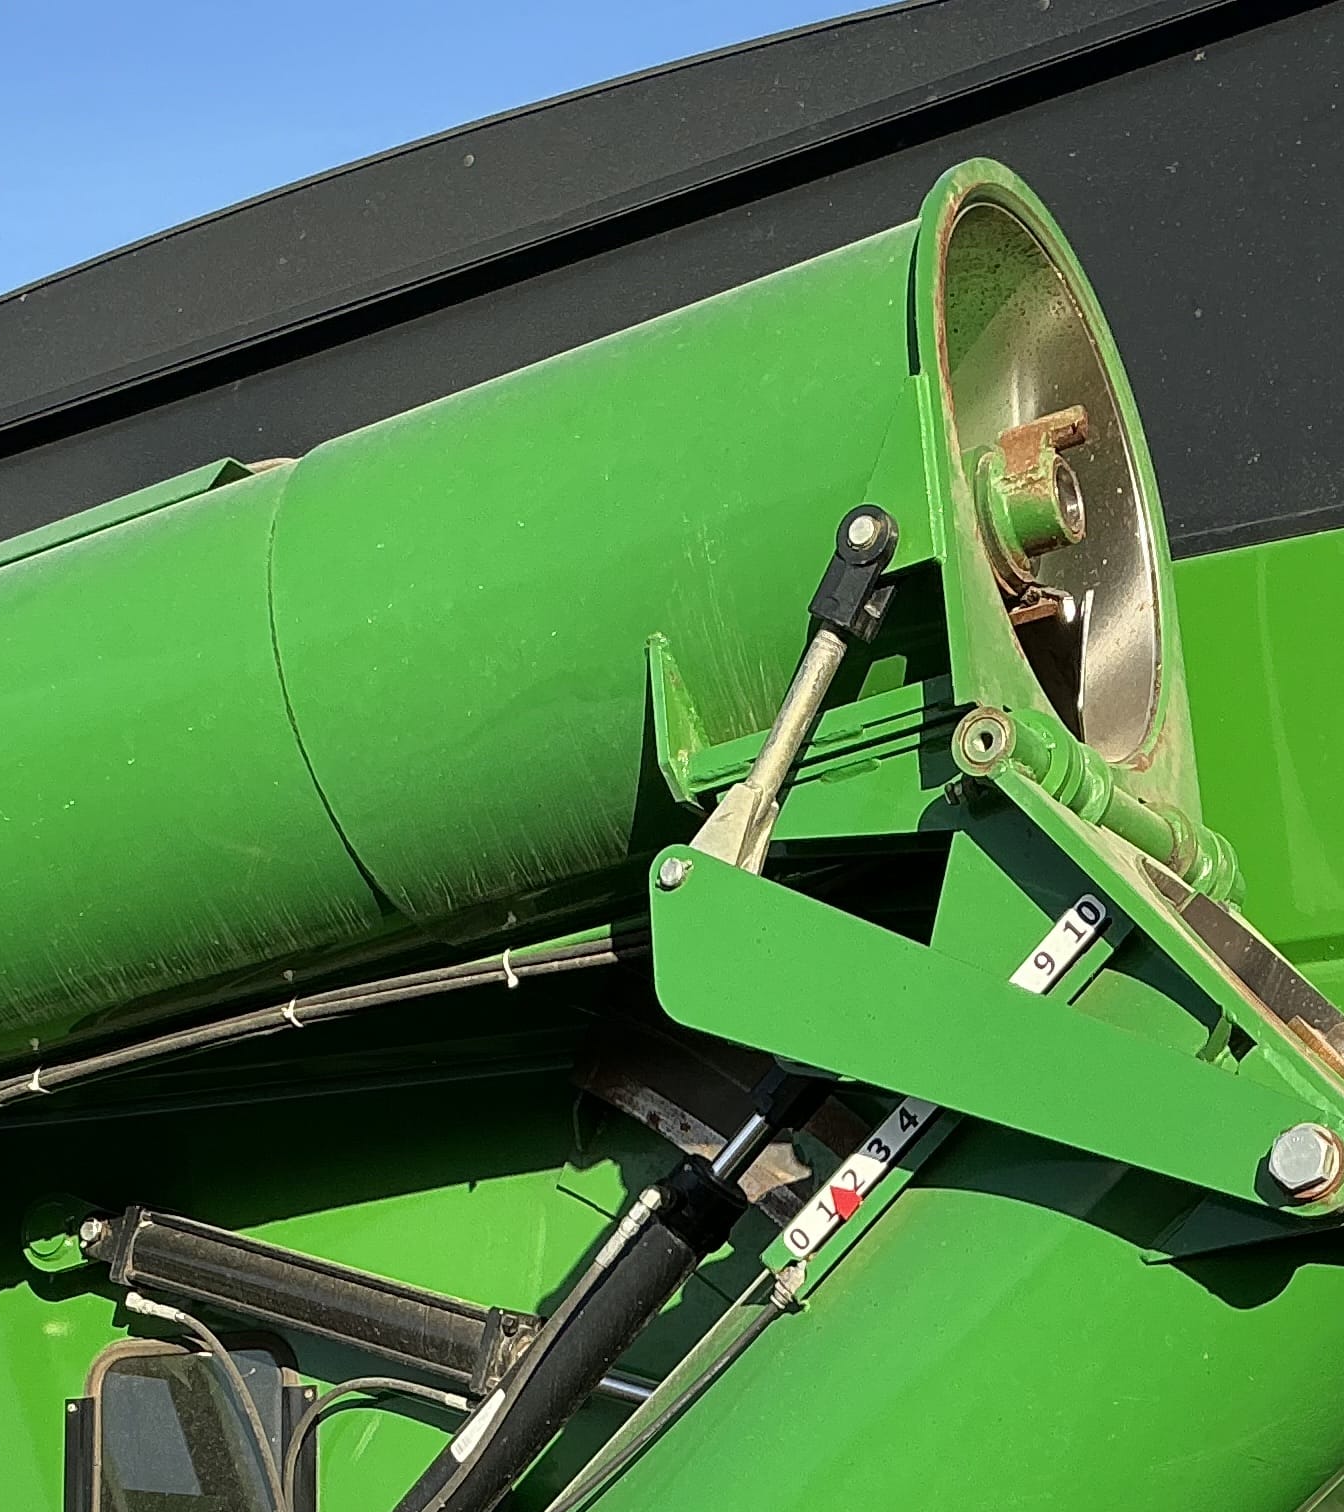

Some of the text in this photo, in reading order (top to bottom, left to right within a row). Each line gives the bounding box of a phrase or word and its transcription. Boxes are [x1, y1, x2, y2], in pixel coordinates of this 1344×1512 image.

[1034, 901, 1101, 976] 9 10
[789, 1107, 920, 1250] 0 1 2 3 4
